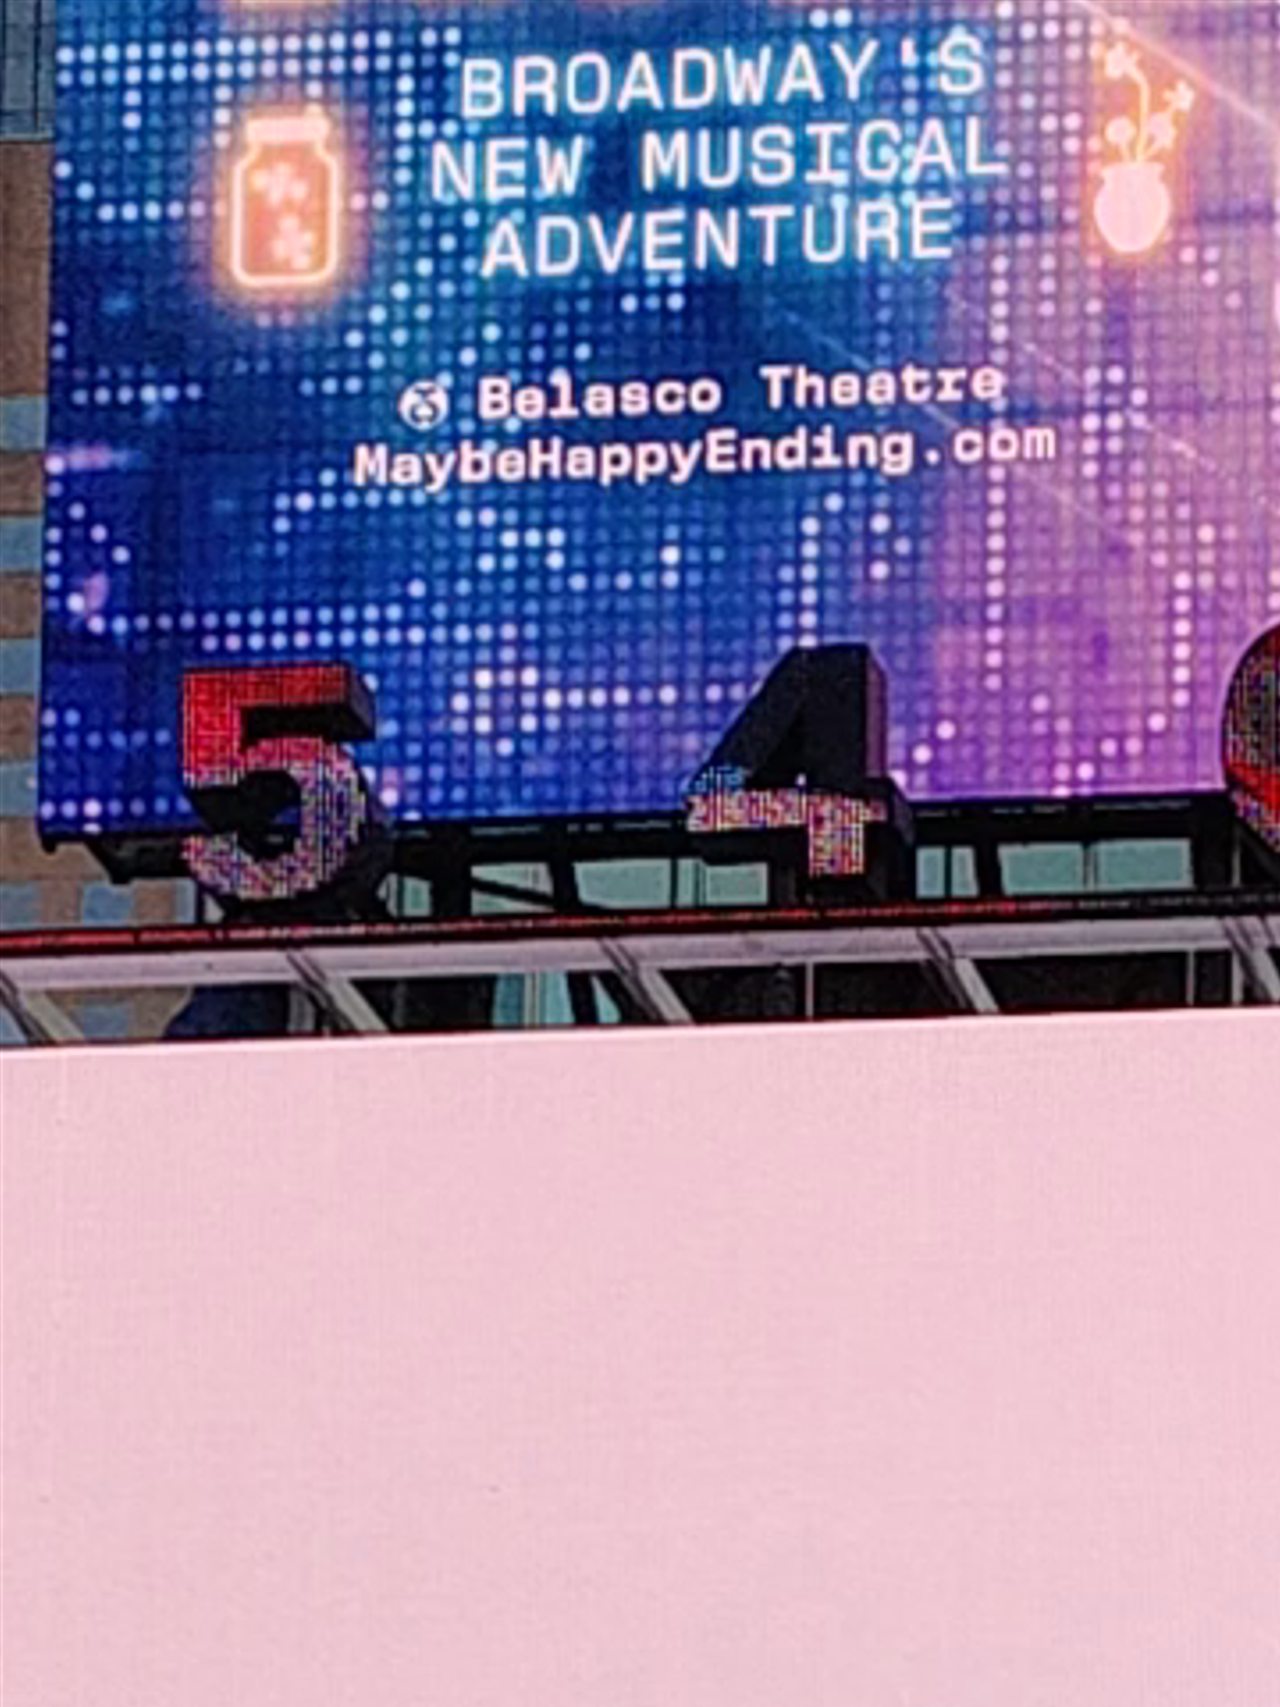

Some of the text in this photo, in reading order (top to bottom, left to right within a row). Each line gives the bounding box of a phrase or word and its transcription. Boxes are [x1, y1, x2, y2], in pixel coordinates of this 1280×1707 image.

[460, 37, 988, 120] BROADWAY'S
[430, 116, 1010, 203] NEW MUSICAL
[480, 197, 957, 280] ADVENTURE
[477, 361, 1007, 422] Belasco Theatre
[353, 421, 1058, 491] MaybeHappyEnding.com
